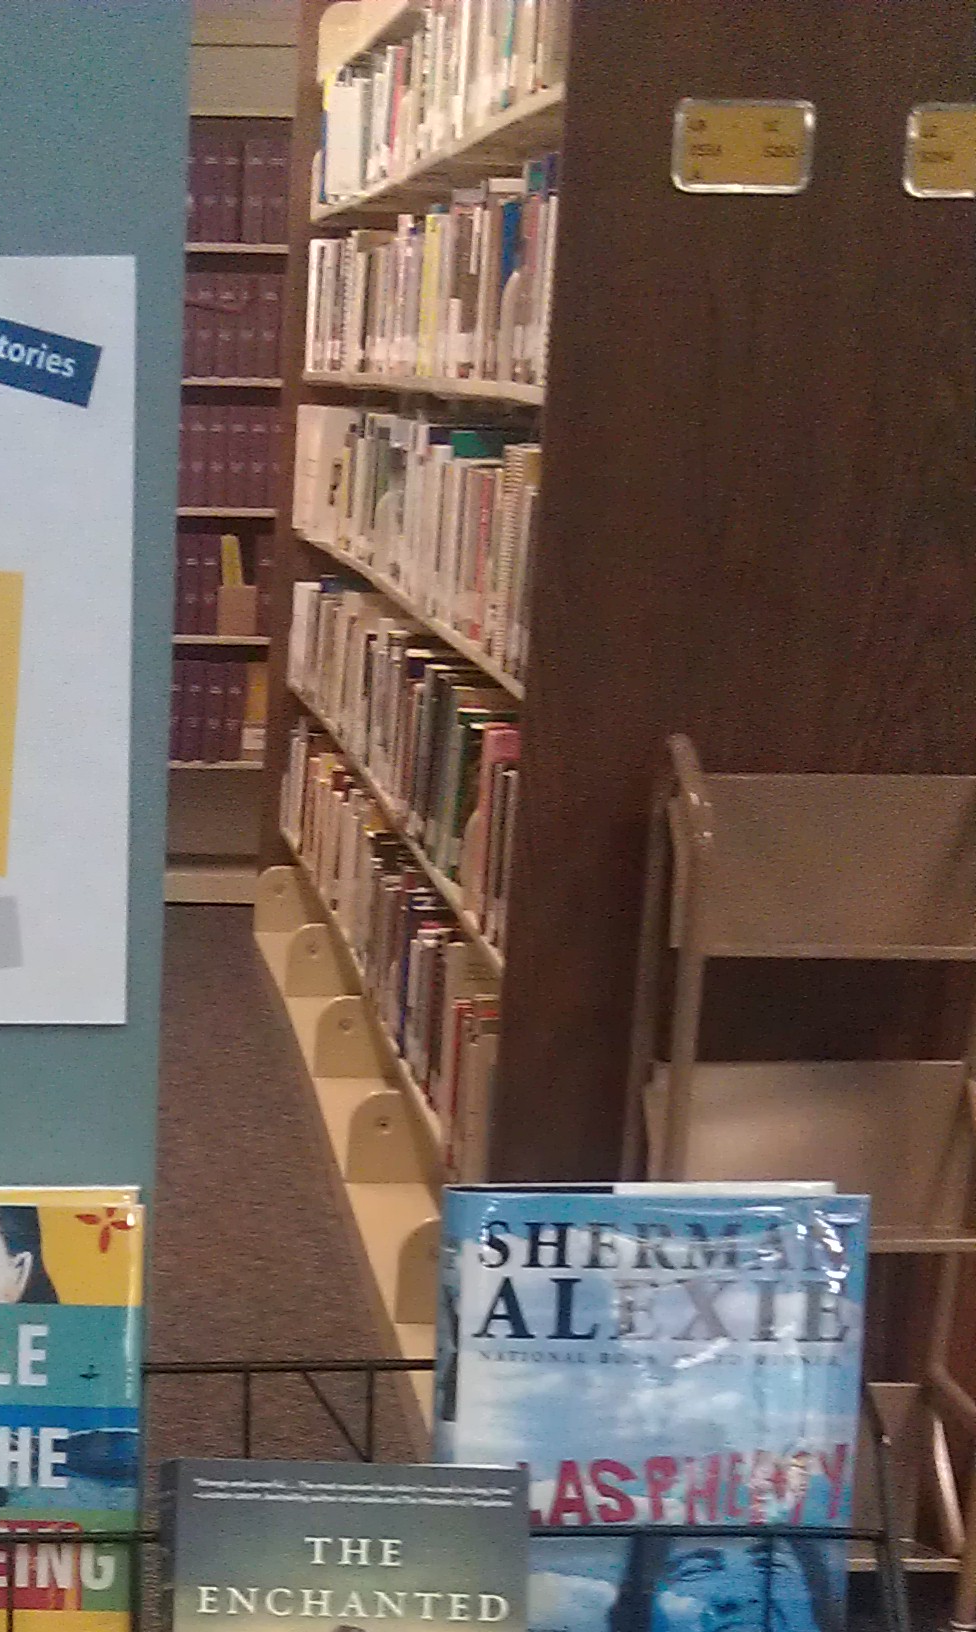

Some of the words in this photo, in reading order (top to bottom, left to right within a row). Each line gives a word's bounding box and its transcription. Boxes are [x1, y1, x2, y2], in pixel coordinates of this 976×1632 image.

[472, 1278, 848, 1342] ALEXIE
[304, 1536, 404, 1567] THE
[197, 1585, 511, 1622] ENCHANTED
